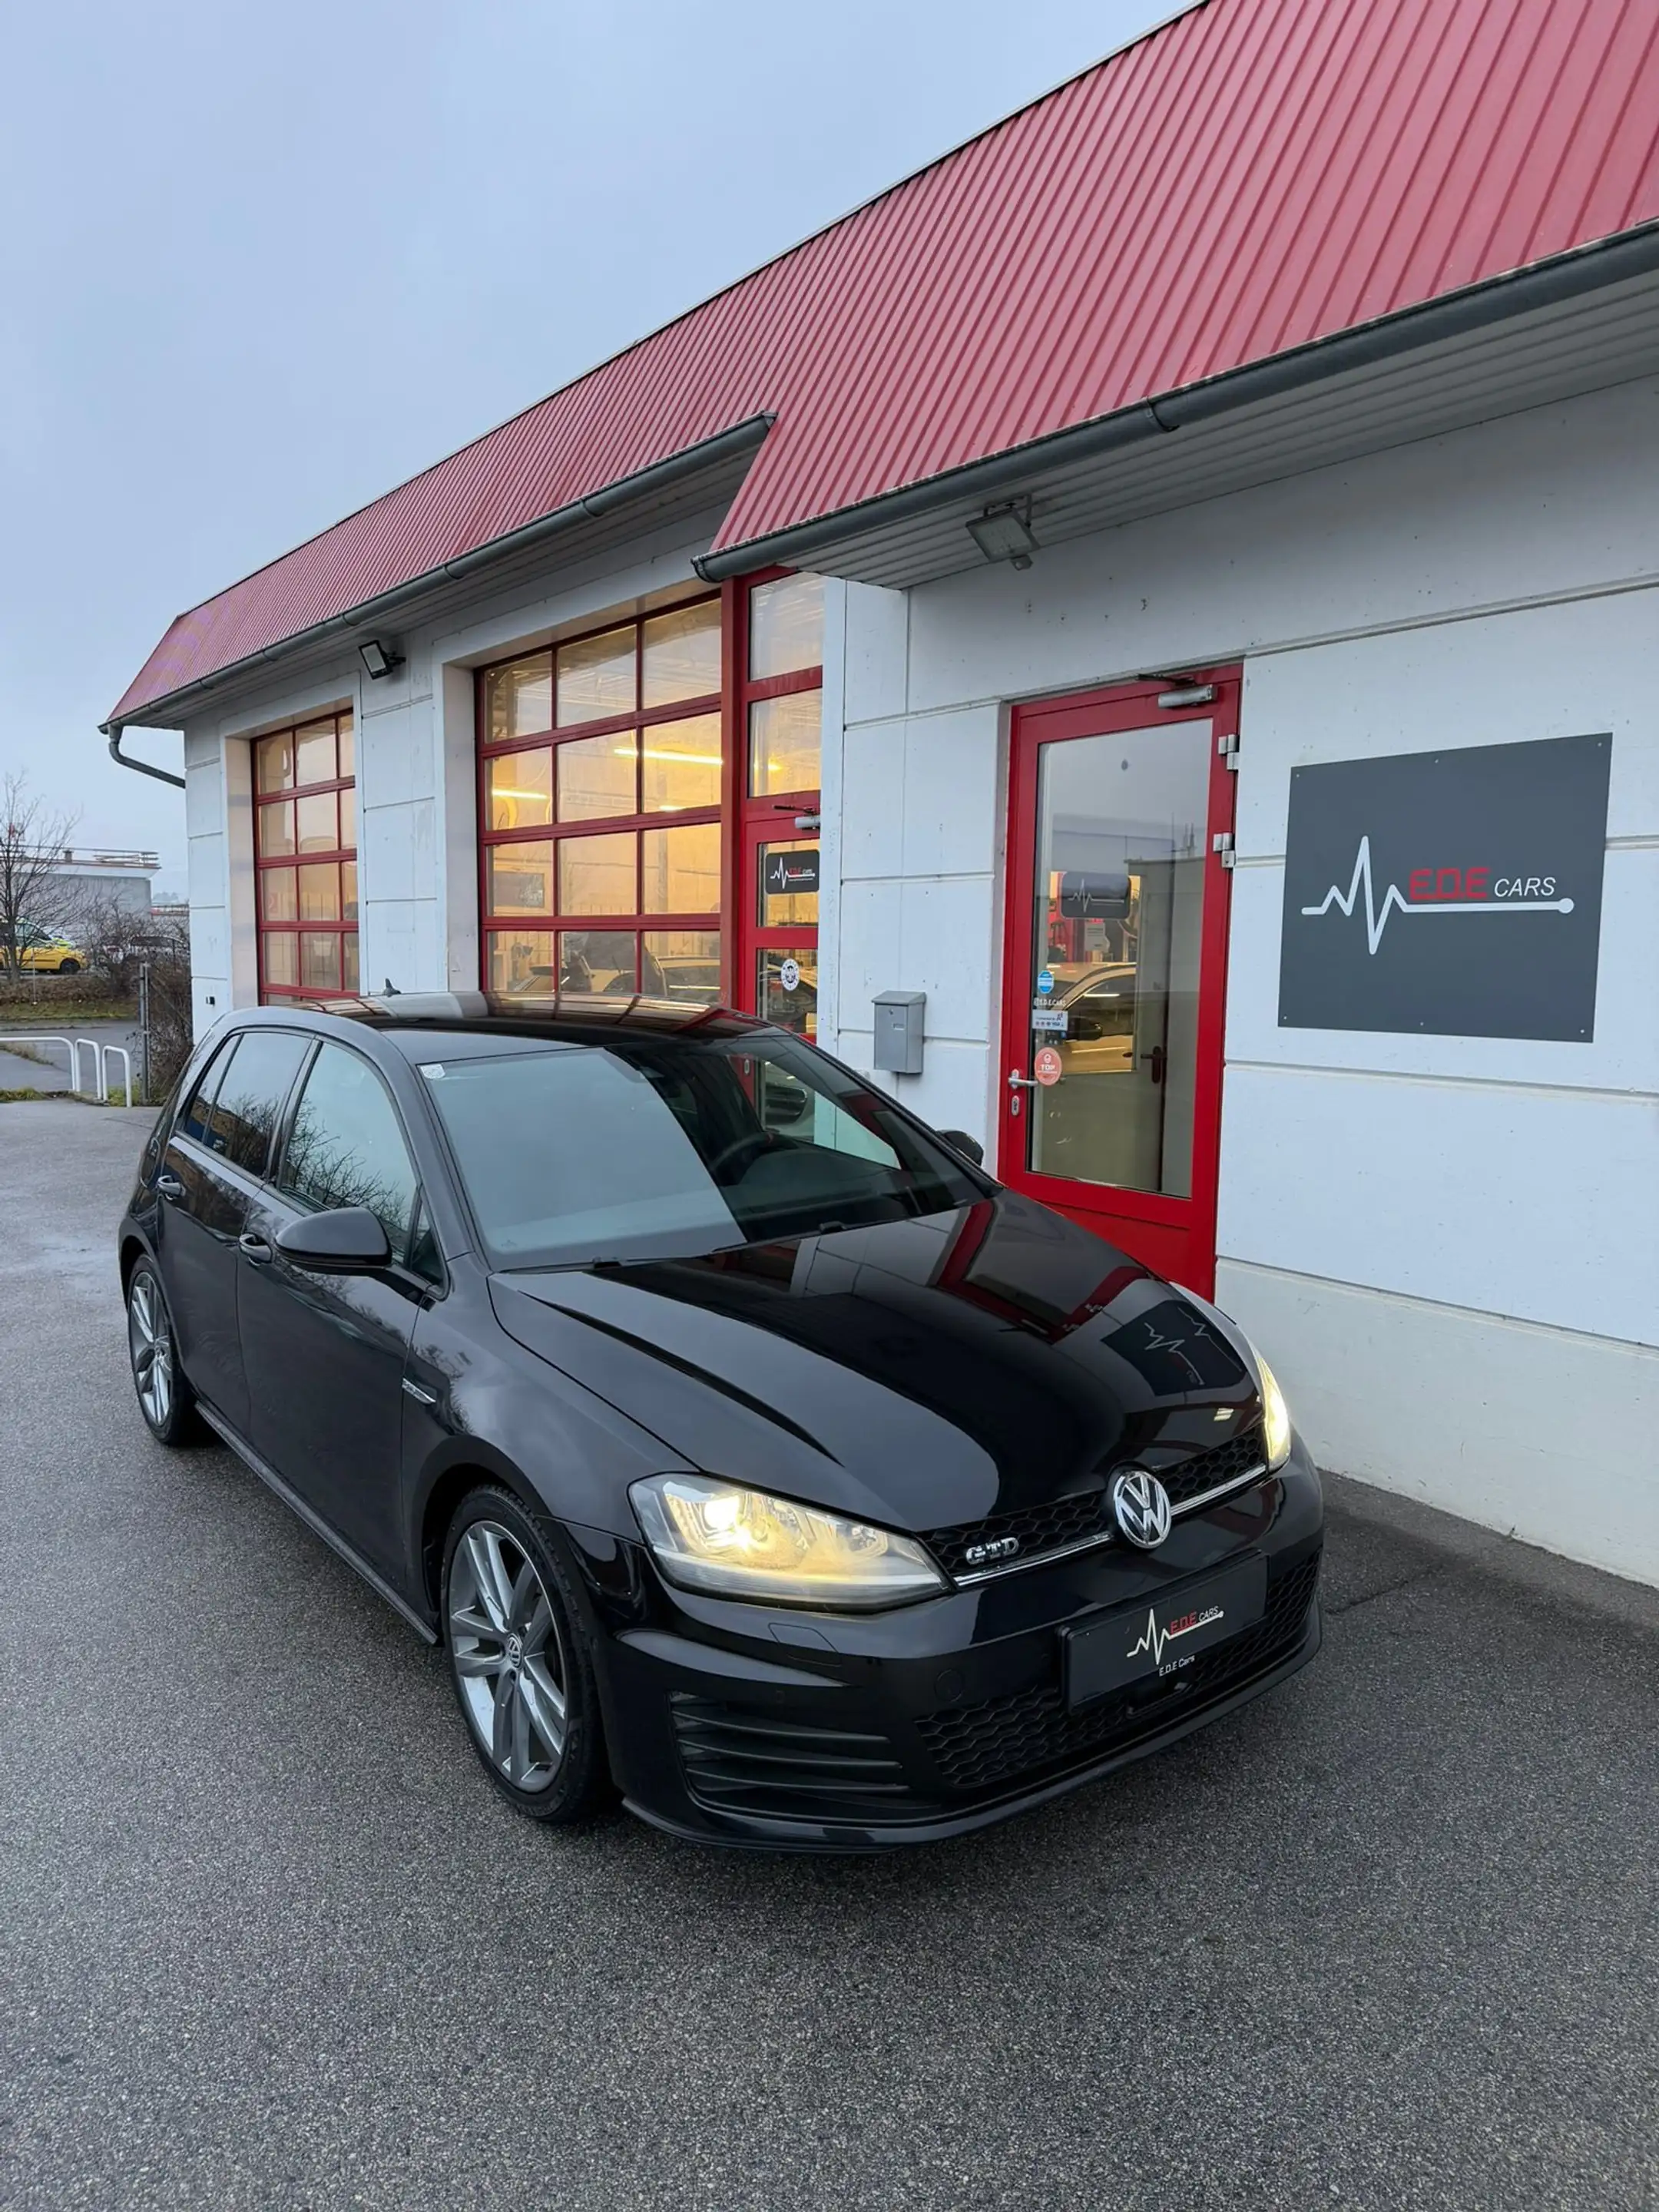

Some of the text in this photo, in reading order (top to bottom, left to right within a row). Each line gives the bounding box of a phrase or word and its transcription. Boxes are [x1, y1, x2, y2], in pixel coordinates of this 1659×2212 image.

[1494, 876, 1556, 897] CARS
[966, 1537, 1019, 1565] GTD
[1198, 1605, 1219, 1621] CARS
[1178, 1654, 1195, 1667] Cars
